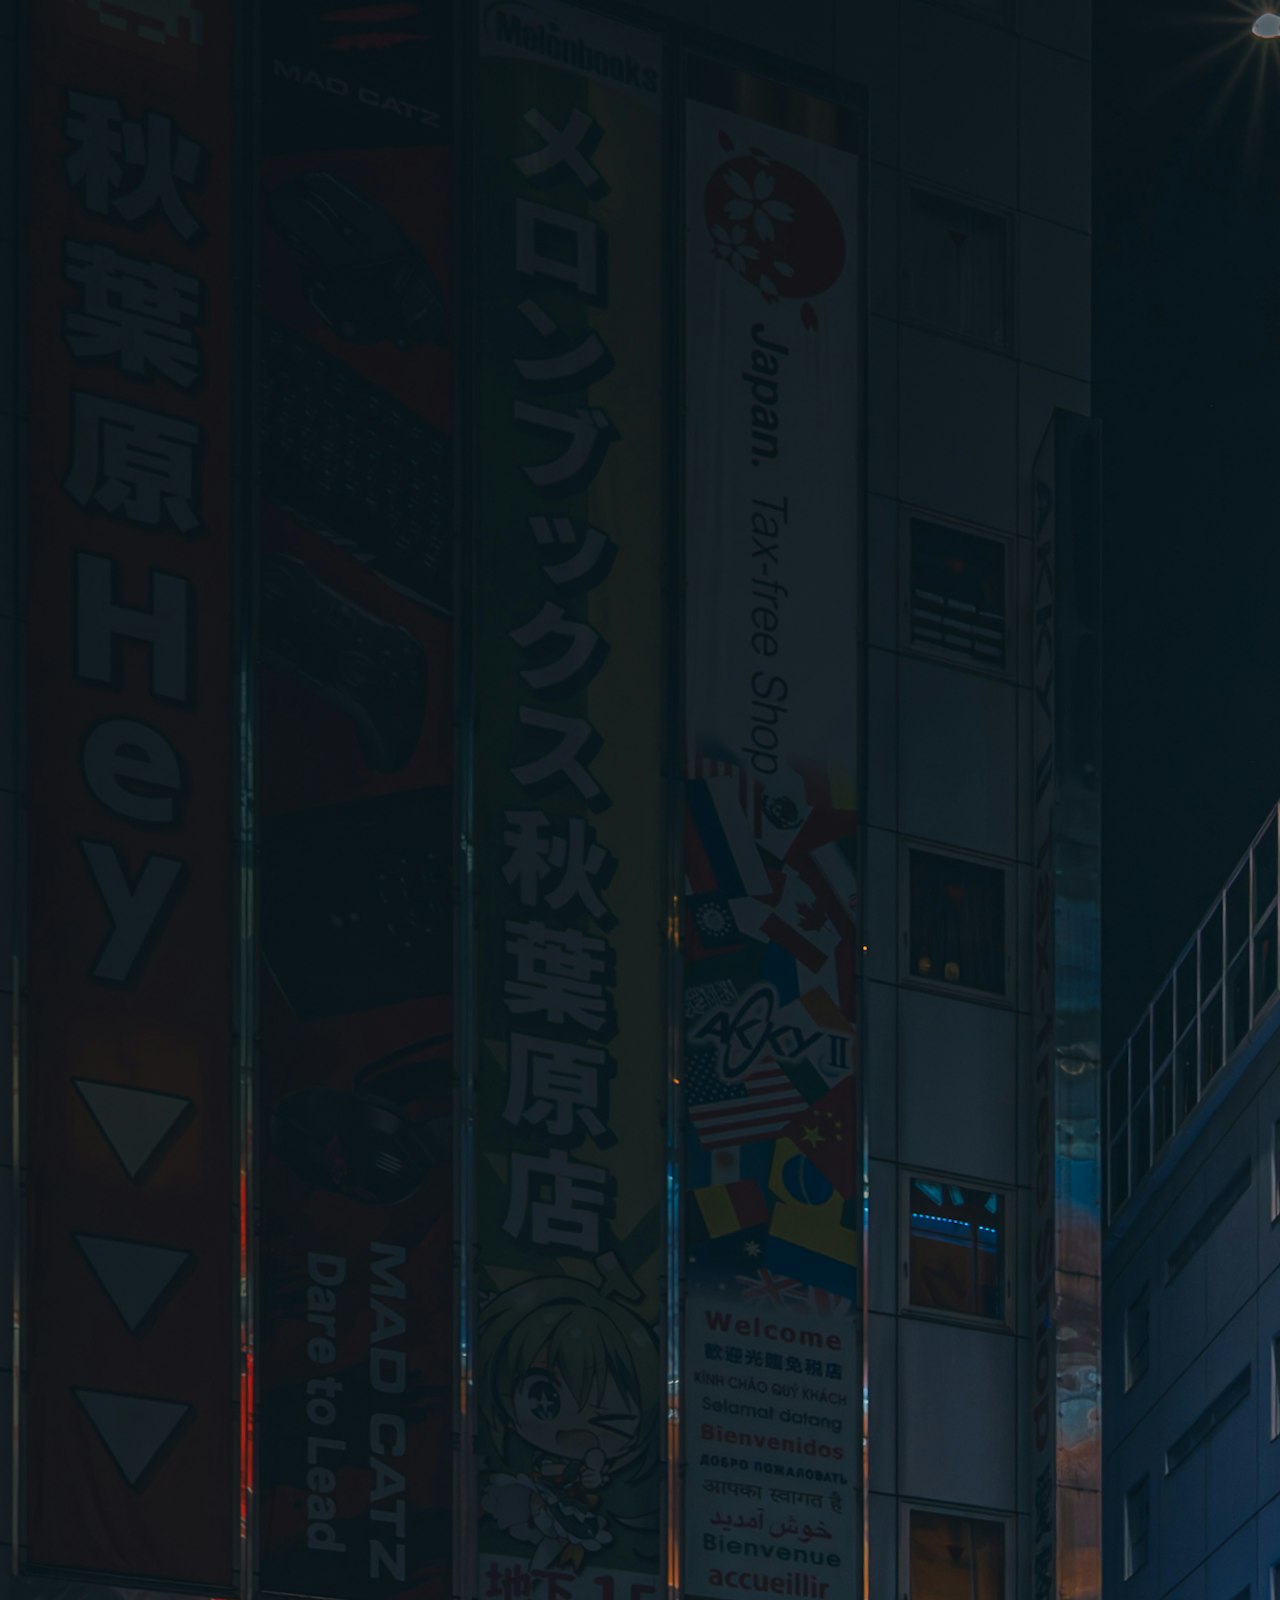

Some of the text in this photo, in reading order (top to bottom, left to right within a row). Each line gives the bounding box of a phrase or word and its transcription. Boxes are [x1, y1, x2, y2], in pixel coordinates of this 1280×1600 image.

[494, 7, 660, 94] Melonbooks
[273, 59, 441, 128] MAD CATZ
[741, 322, 790, 777] Japan. Tax-free Shop
[502, 105, 616, 1251] メロンブックス秋葉原店
[704, 1309, 843, 1352] Welcome
[306, 1251, 347, 1552] Dare to Lead
[369, 1240, 407, 1582] MAD CATZ
[702, 1396, 843, 1435] Selamat datang
[700, 1424, 844, 1461] Bienvenidos
[699, 1453, 848, 1485] ДОБРО ПОЖАЛОВАТЬ
[703, 1478, 763, 1502] आपका
[703, 1534, 842, 1568] Bienvenue
[708, 1568, 830, 1600] accueillir
